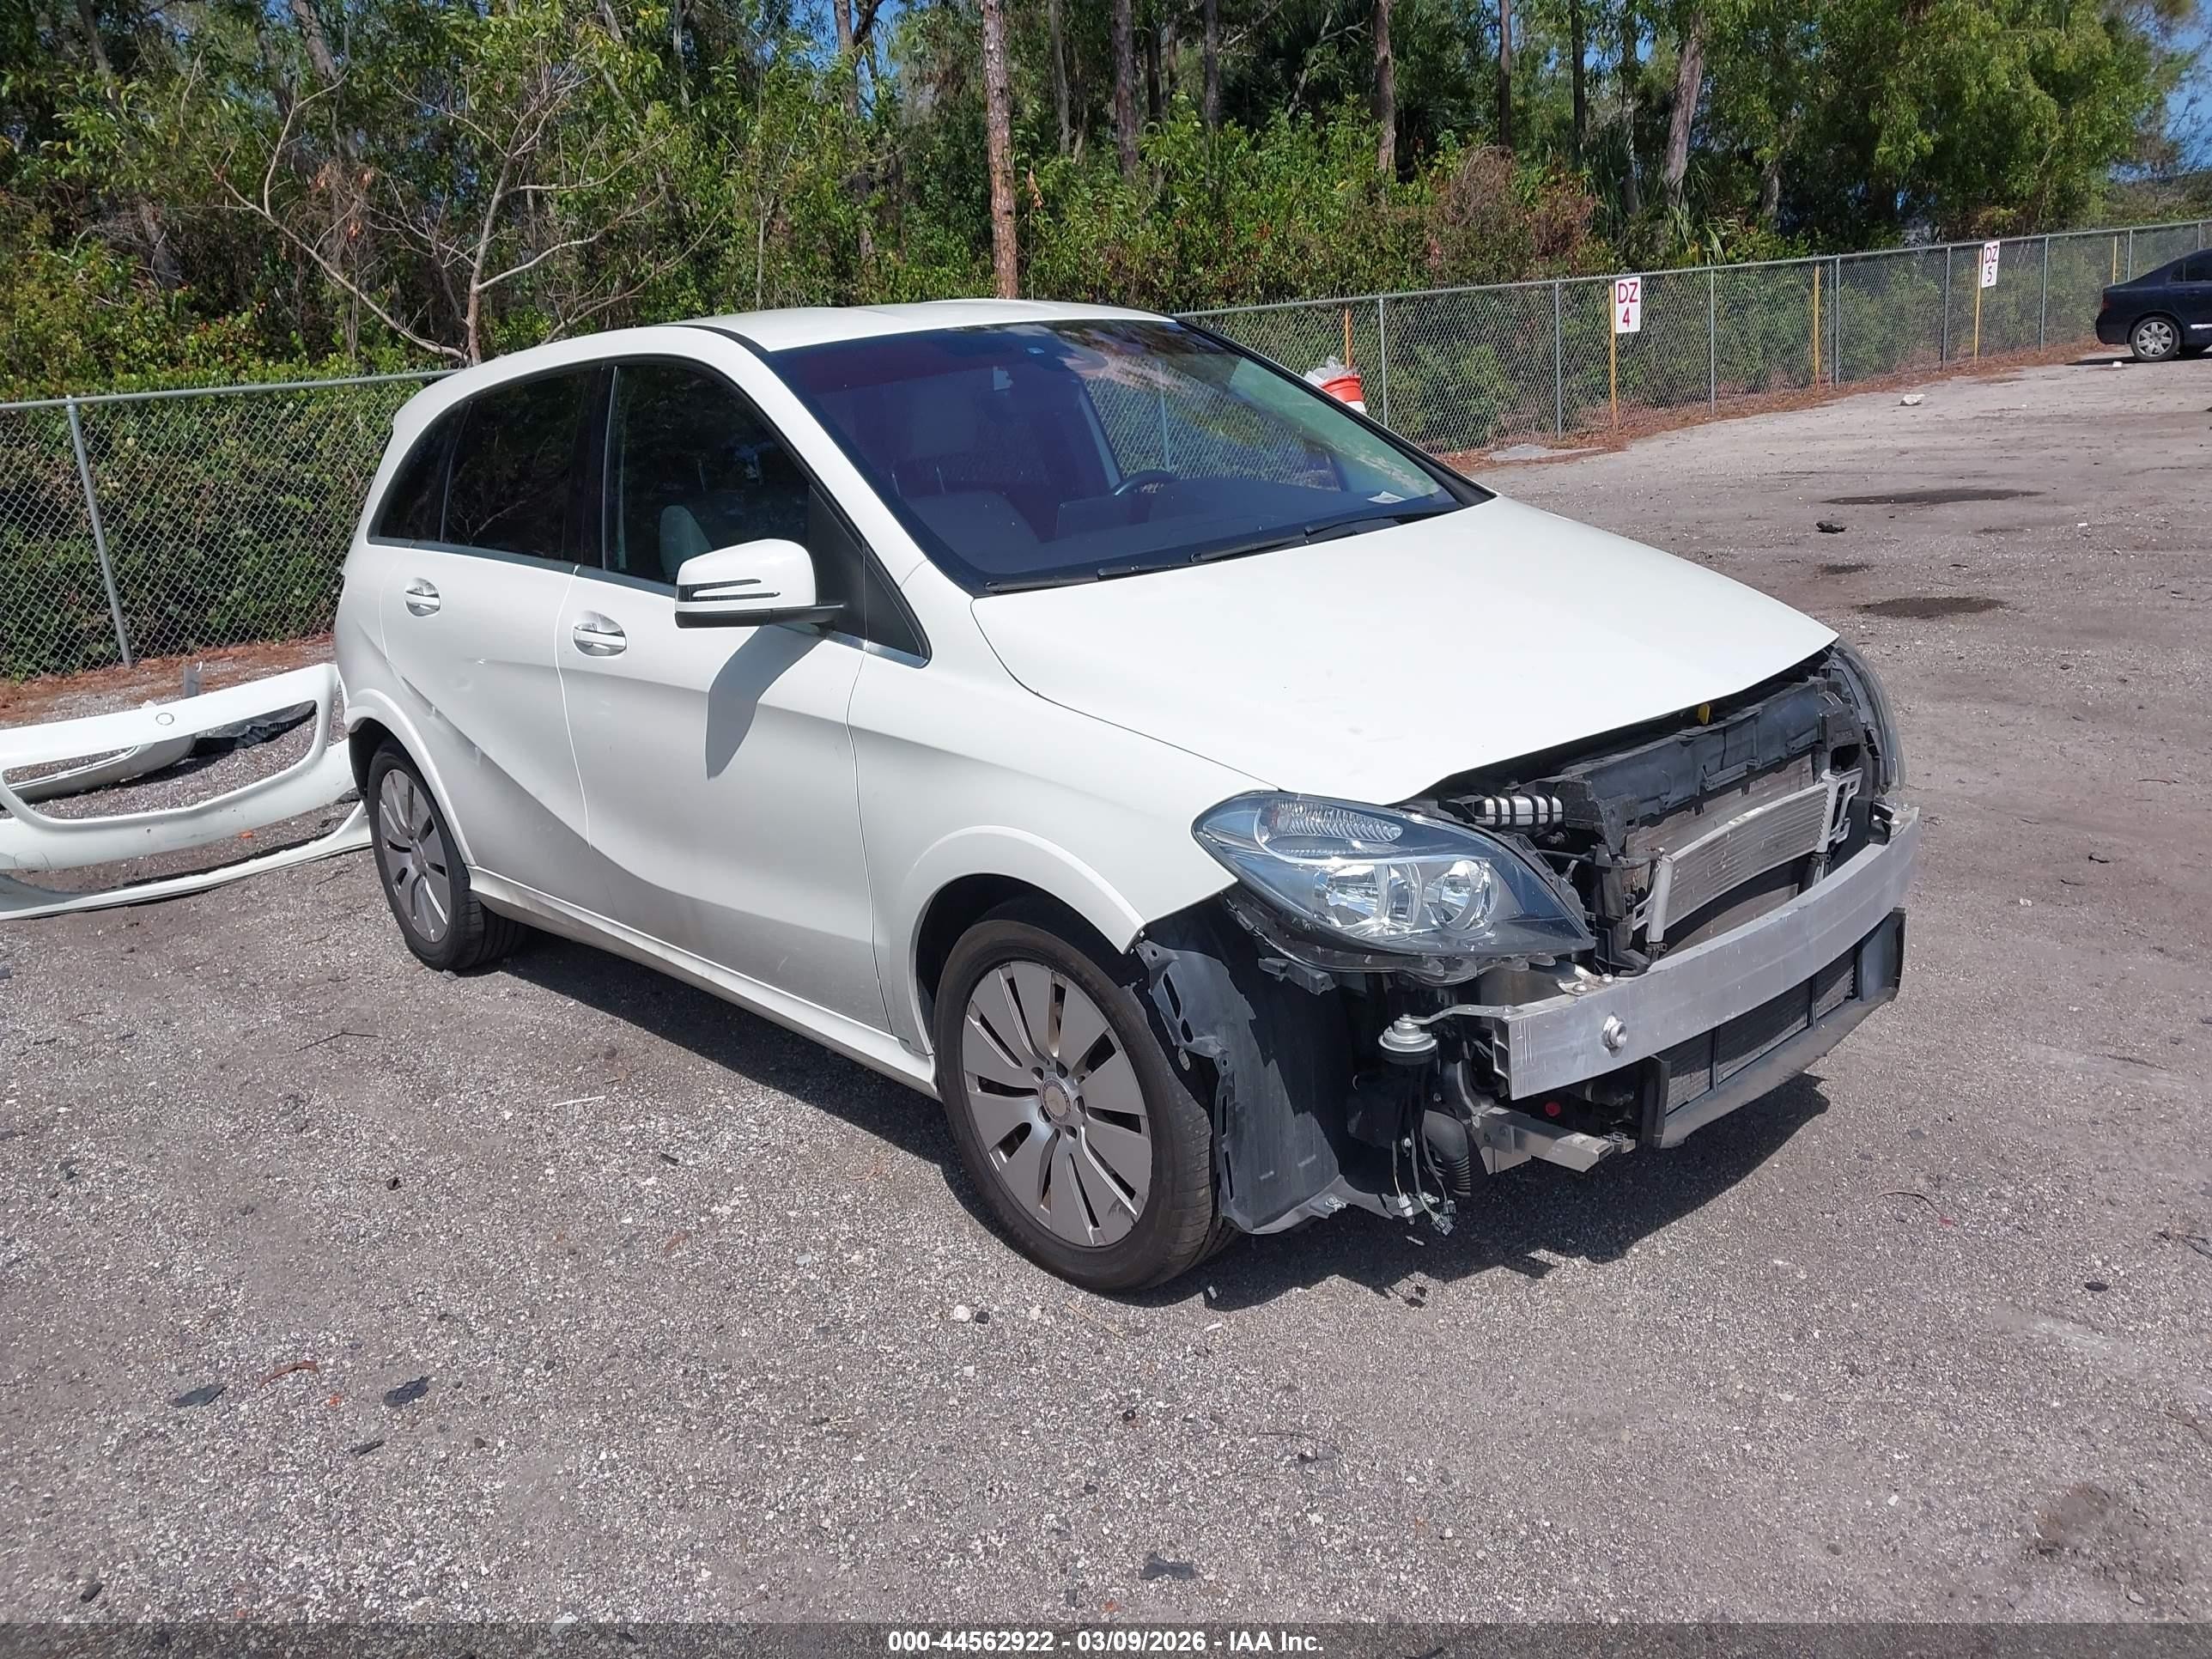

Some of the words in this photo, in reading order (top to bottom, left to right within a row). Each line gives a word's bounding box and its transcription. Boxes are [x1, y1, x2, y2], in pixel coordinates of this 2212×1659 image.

[1984, 245, 1999, 264] DZ
[1987, 265, 1993, 283] 5
[1618, 282, 1638, 303] DZ
[1622, 307, 1631, 328] 4
